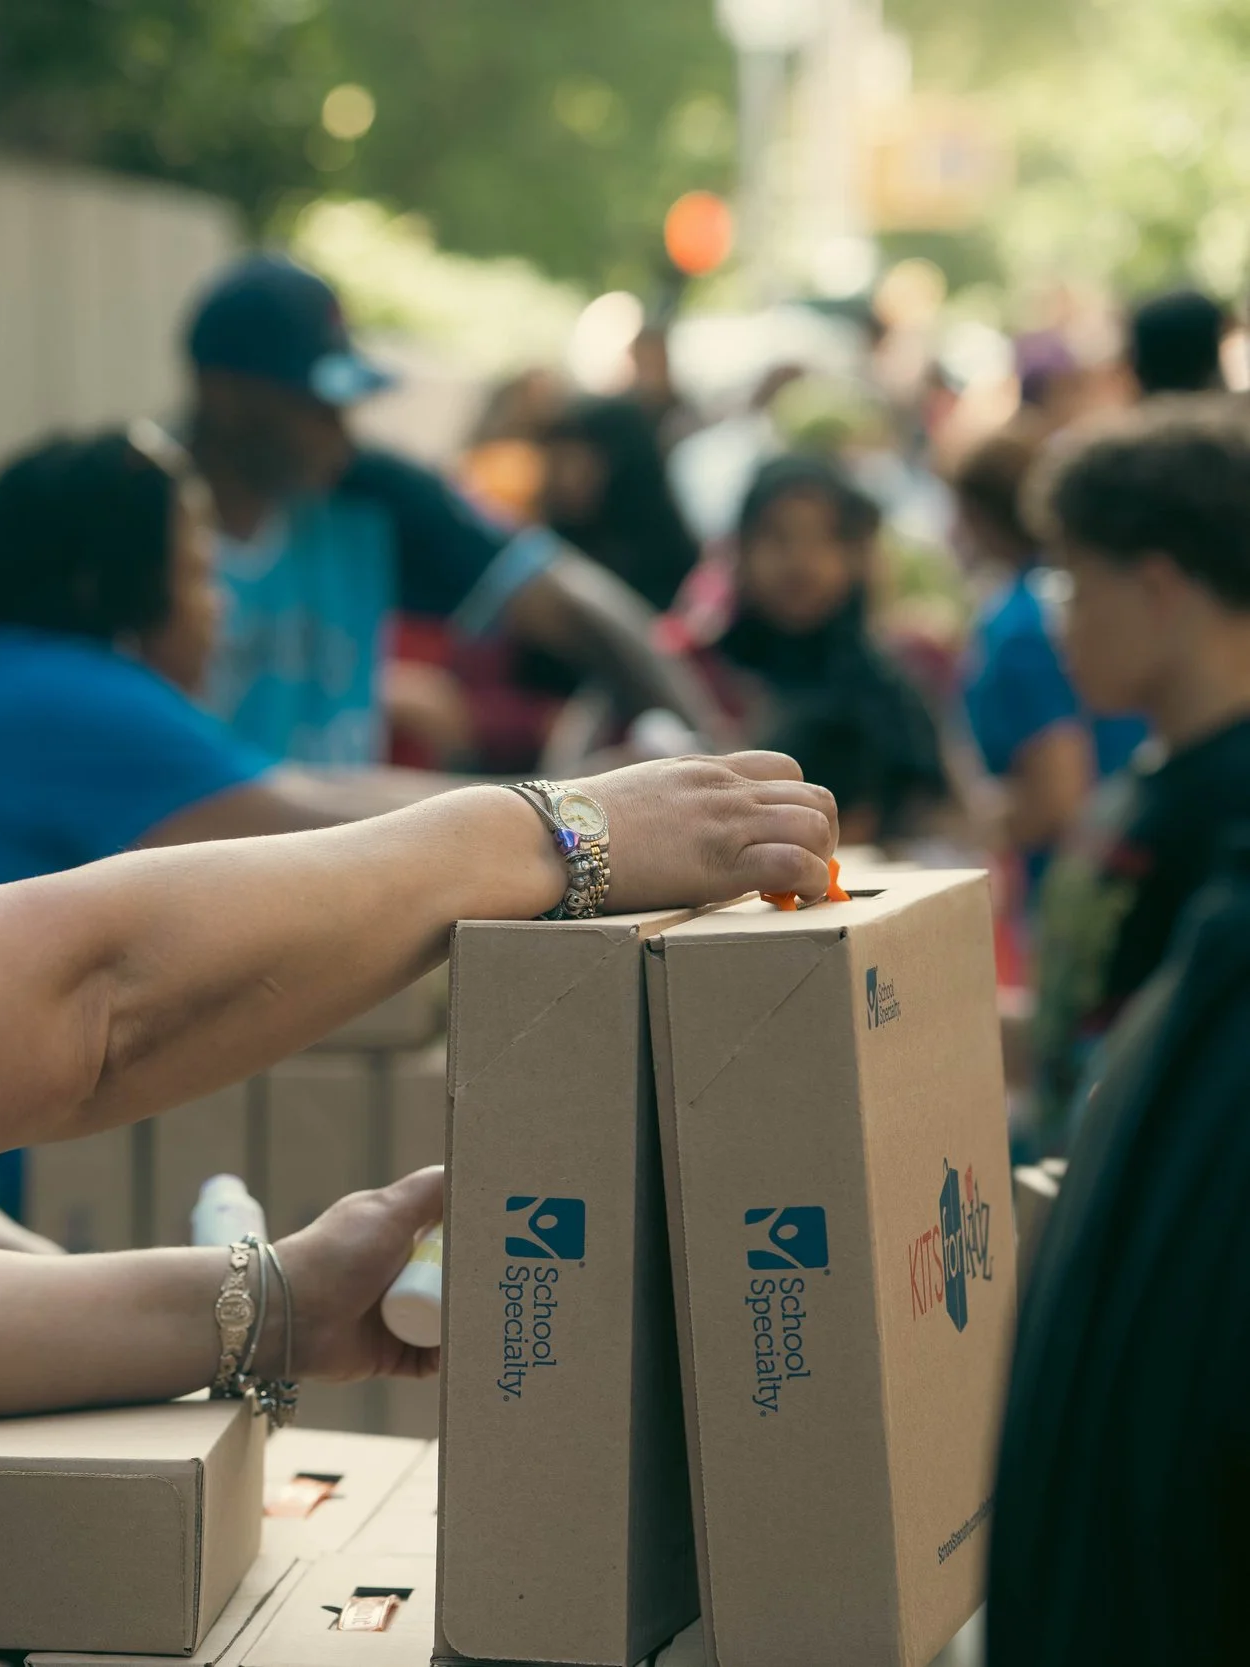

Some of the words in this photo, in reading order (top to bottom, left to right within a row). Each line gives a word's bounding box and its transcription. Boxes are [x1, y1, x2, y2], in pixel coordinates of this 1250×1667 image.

[532, 1266, 559, 1368] School
[908, 1224, 944, 1321] KITS
[942, 1206, 963, 1283] for
[497, 1265, 530, 1399] Specialty
[745, 1279, 782, 1413] Specialty
[779, 1278, 811, 1380] School
